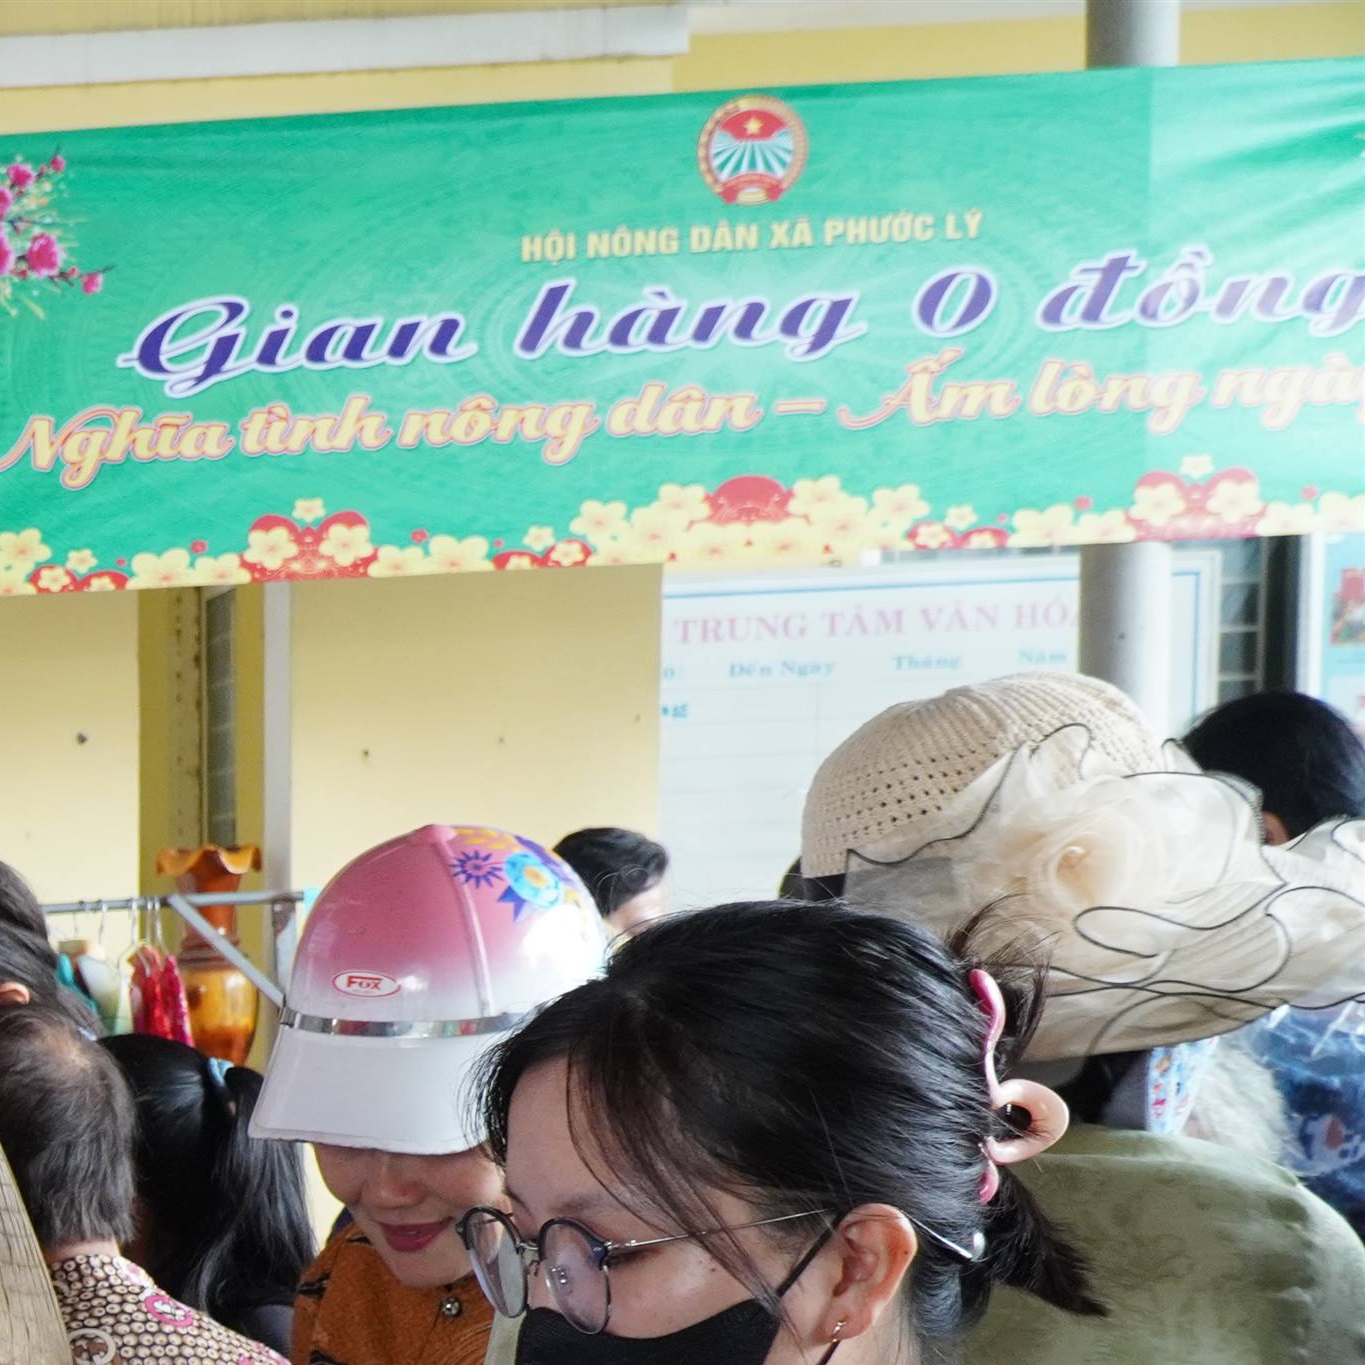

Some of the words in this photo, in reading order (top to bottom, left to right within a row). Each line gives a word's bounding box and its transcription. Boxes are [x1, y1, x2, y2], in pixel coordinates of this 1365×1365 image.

[521, 229, 575, 265] HỘI
[586, 224, 679, 258] NÔNG
[690, 219, 759, 254] DÂN
[770, 215, 814, 249] XÃ
[823, 210, 935, 246] PHƯỚC
[945, 207, 983, 240] LÝ
[119, 295, 476, 398] Gian
[513, 277, 869, 362] hàng
[1035, 245, 1365, 337] đồng
[238, 395, 392, 458] tình
[399, 395, 599, 465] nông
[607, 382, 763, 437] dân
[837, 347, 1024, 431] Ấm
[1029, 359, 1206, 435] lòng
[1210, 351, 1365, 431] ngà
[674, 611, 809, 645] TRUNG
[822, 605, 908, 640] TÂM
[910, 602, 1000, 633] VĂN
[1014, 593, 1079, 630] HÓ
